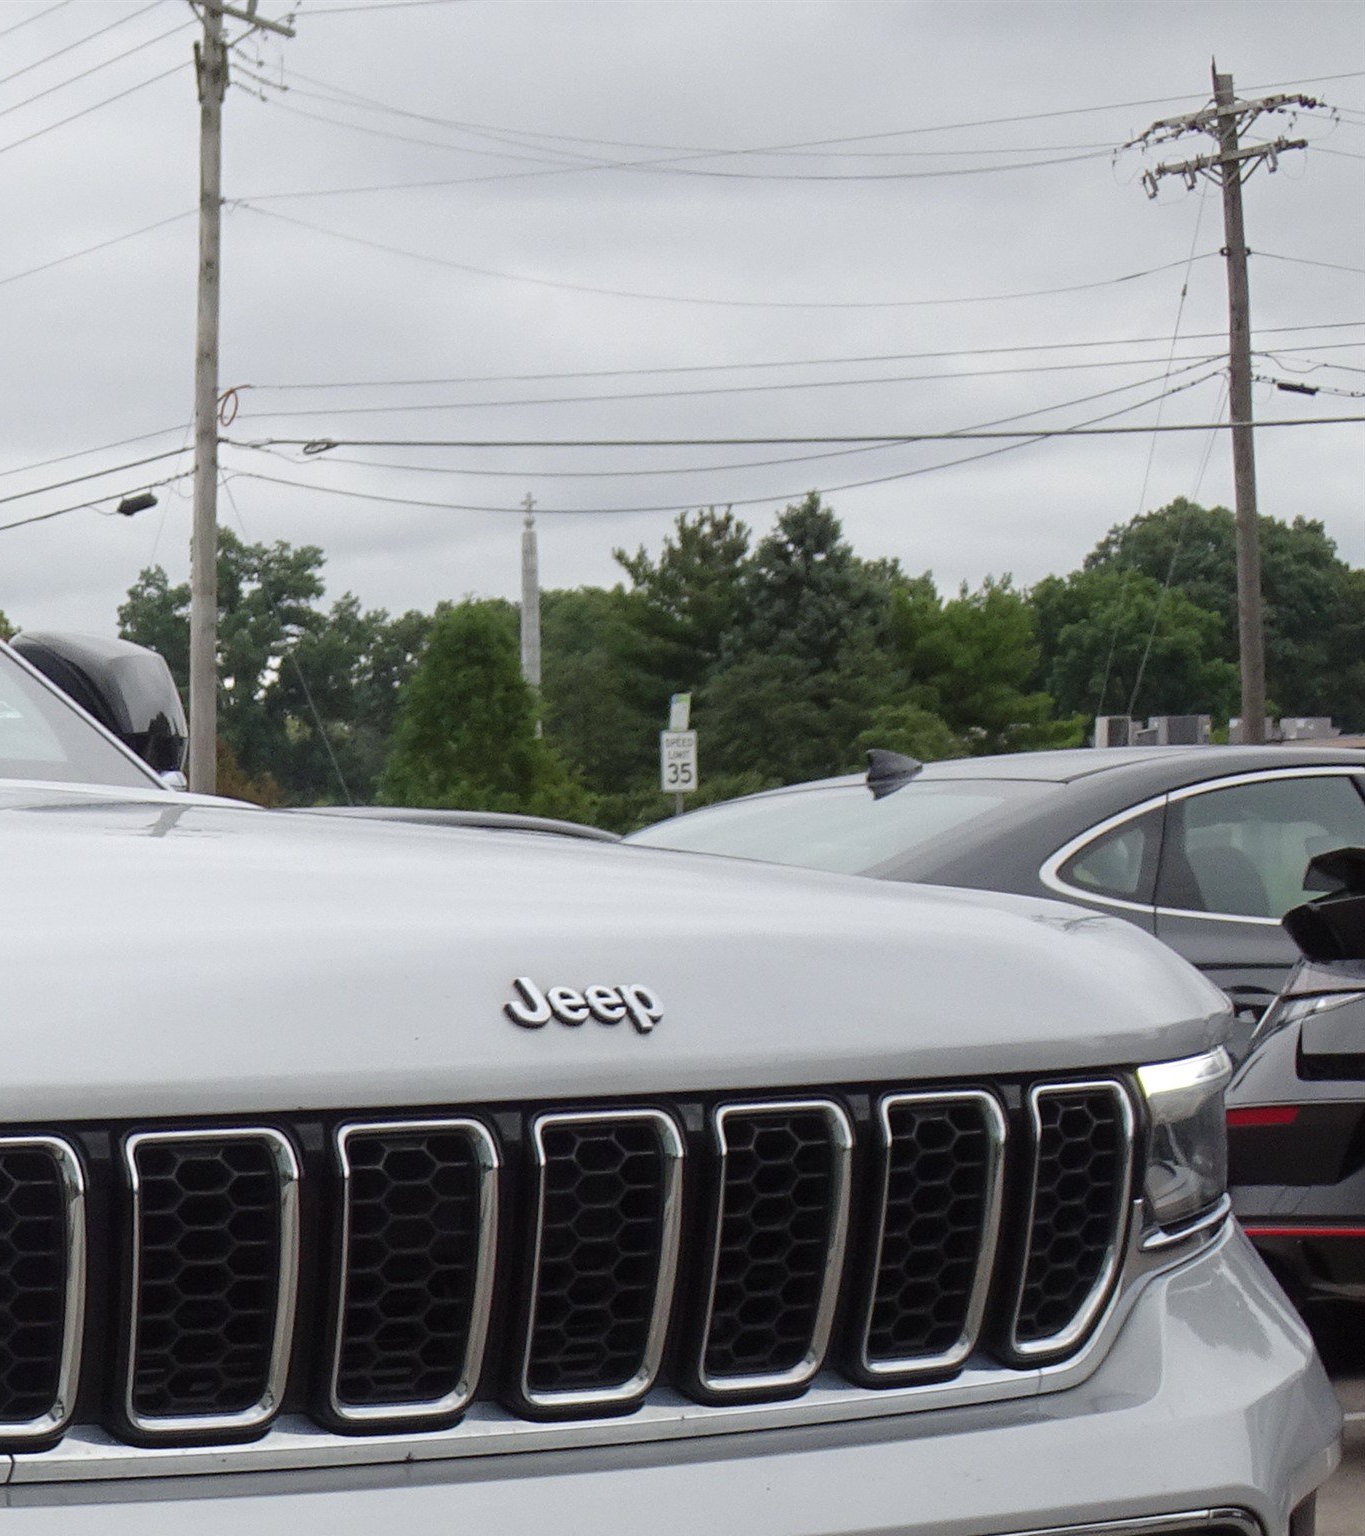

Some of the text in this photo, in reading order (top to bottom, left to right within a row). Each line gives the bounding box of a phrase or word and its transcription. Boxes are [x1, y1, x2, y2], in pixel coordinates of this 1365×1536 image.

[665, 738, 694, 748] SPEED
[668, 750, 691, 761] LIMIT
[667, 762, 693, 784] 35
[503, 976, 664, 1034] Jeep
